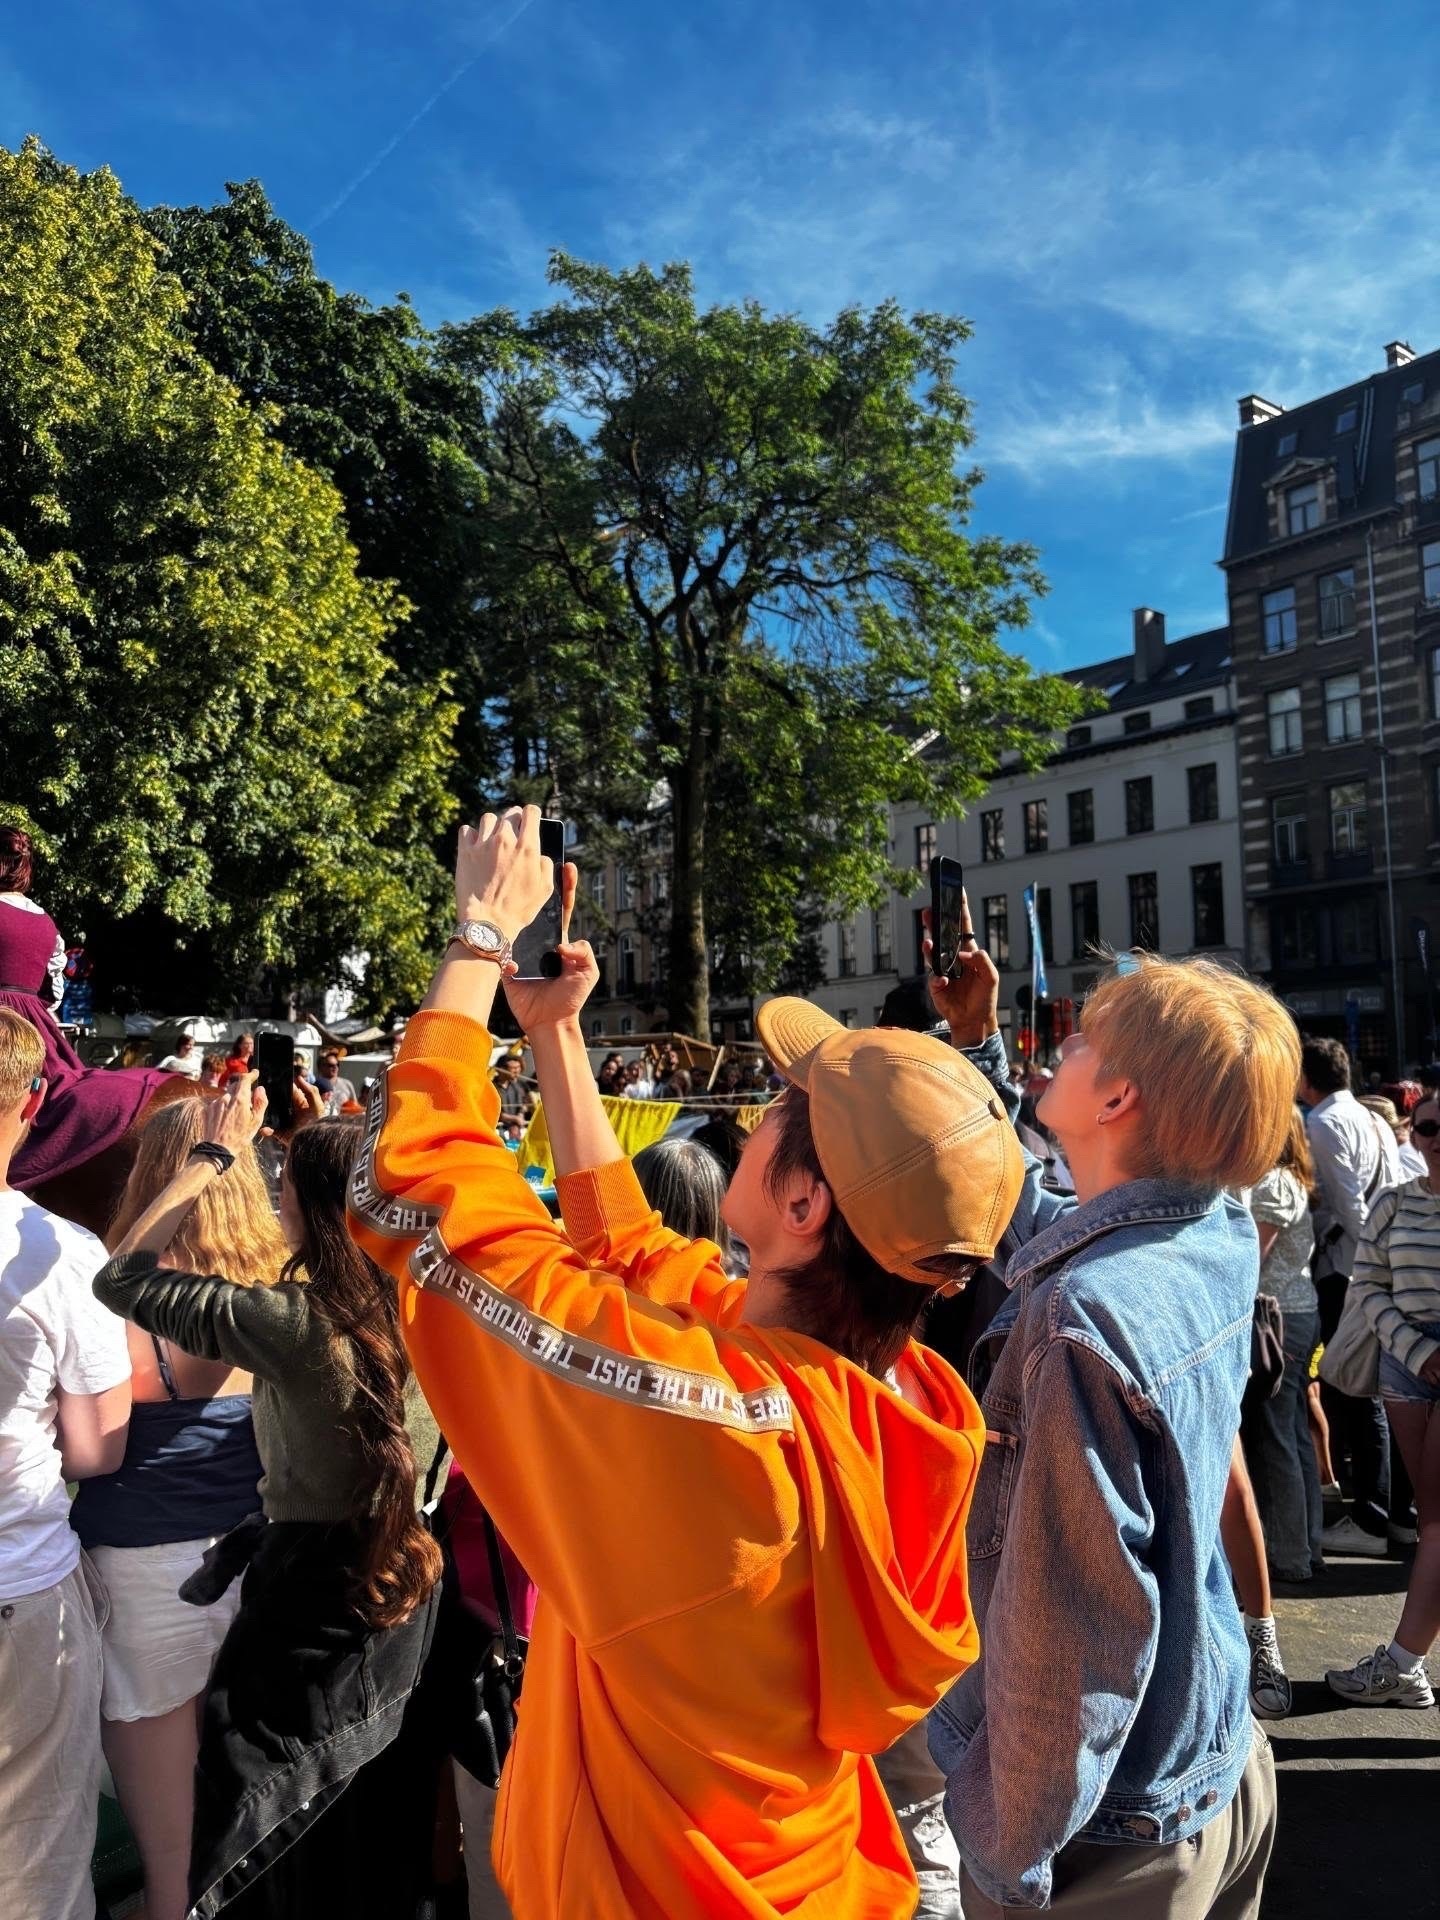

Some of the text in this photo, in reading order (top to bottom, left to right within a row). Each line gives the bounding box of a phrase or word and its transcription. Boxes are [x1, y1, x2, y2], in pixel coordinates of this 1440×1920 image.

[368, 1092, 383, 1132] THE
[354, 1153, 370, 1175] IS
[390, 1205, 430, 1230] THE
[431, 1261, 457, 1288] IN
[456, 1276, 475, 1303] IS
[473, 1290, 533, 1346] FUTURE
[532, 1331, 575, 1370] THE
[586, 1355, 642, 1394] PAST
[648, 1372, 691, 1406] THE
[701, 1385, 724, 1410] IN
